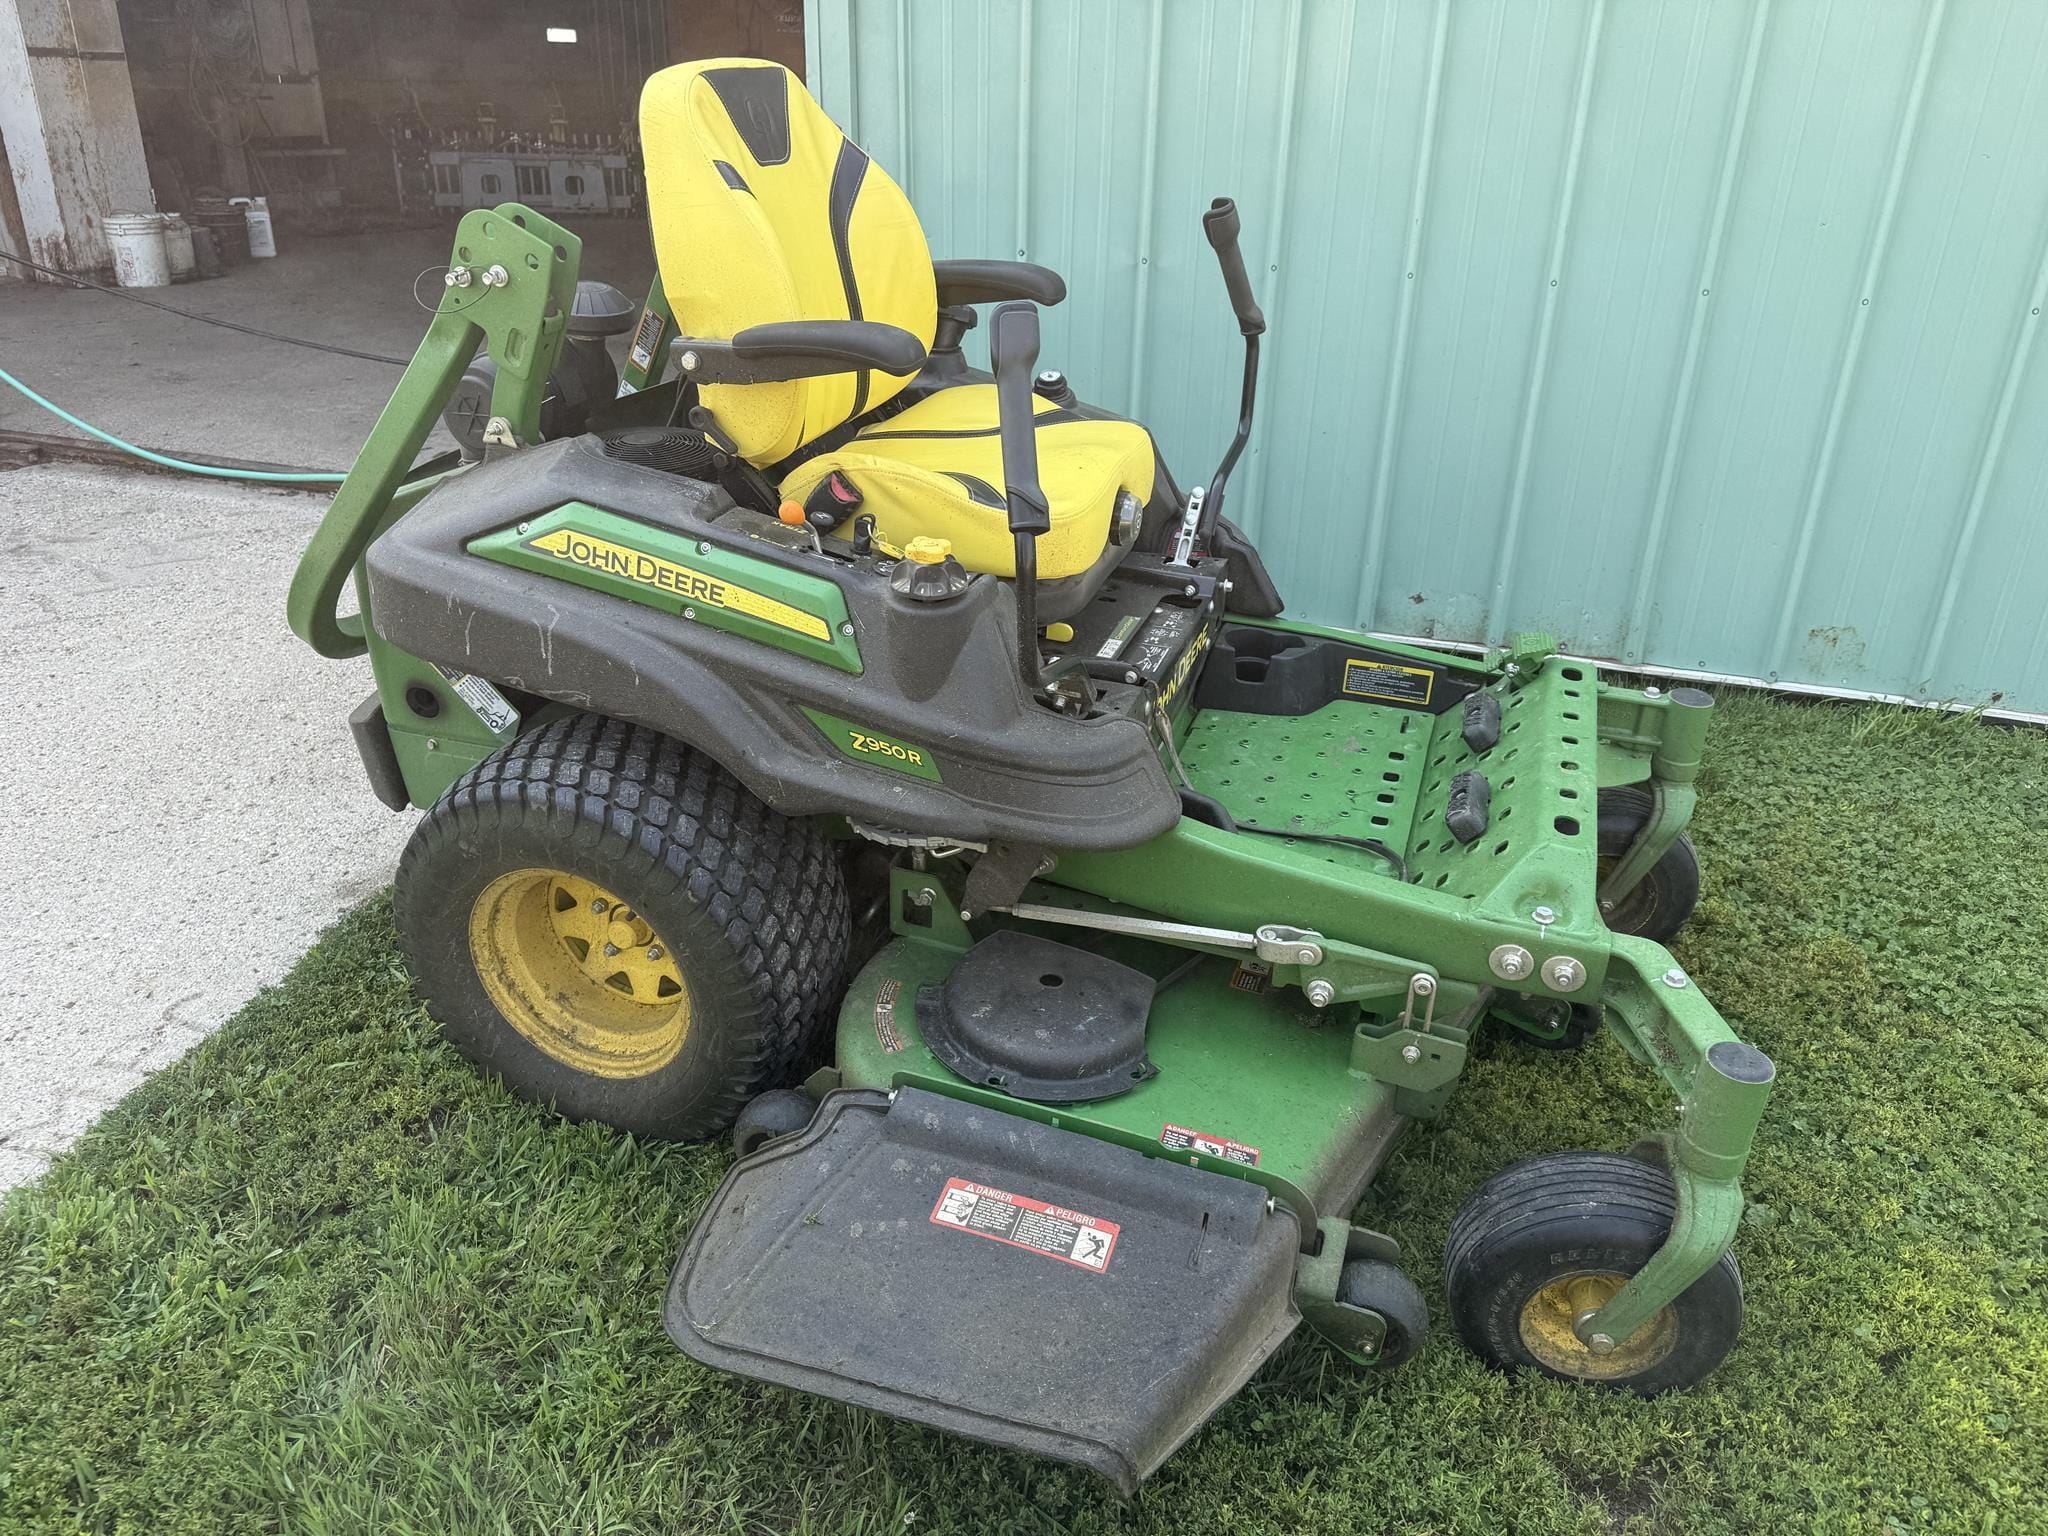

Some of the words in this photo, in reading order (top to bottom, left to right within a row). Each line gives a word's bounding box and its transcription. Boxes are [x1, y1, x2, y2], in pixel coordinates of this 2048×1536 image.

[556, 533, 629, 574] JOHN
[635, 554, 726, 606] DEERE
[1178, 622, 1210, 685] DEERE
[848, 731, 923, 766] Z950R
[1230, 1141, 1260, 1154] PELIGRO
[975, 1185, 1014, 1203] DANGER
[1055, 1207, 1097, 1228] PELIGRO
